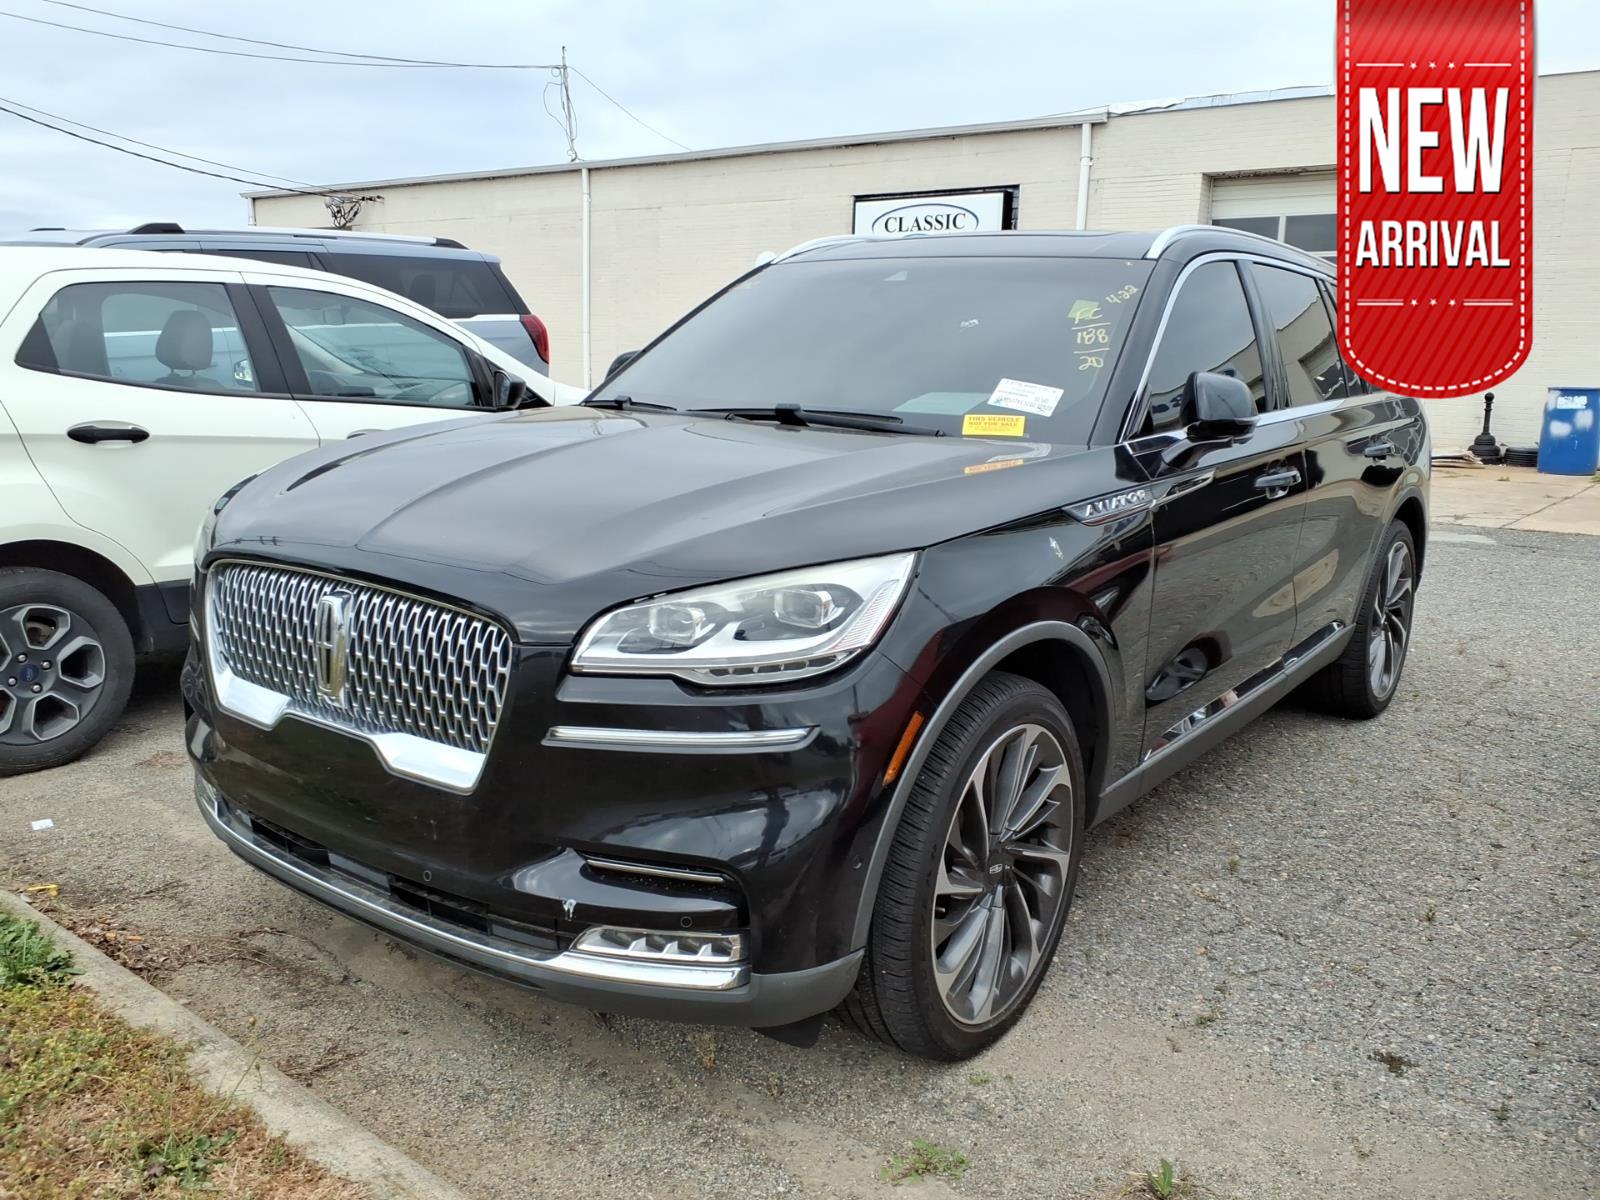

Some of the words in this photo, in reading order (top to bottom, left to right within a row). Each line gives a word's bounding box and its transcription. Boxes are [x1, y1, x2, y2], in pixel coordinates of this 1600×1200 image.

[884, 212, 966, 233] CLASSIC
[1077, 328, 1108, 344] 188
[1085, 489, 1146, 517] AVIATOR
